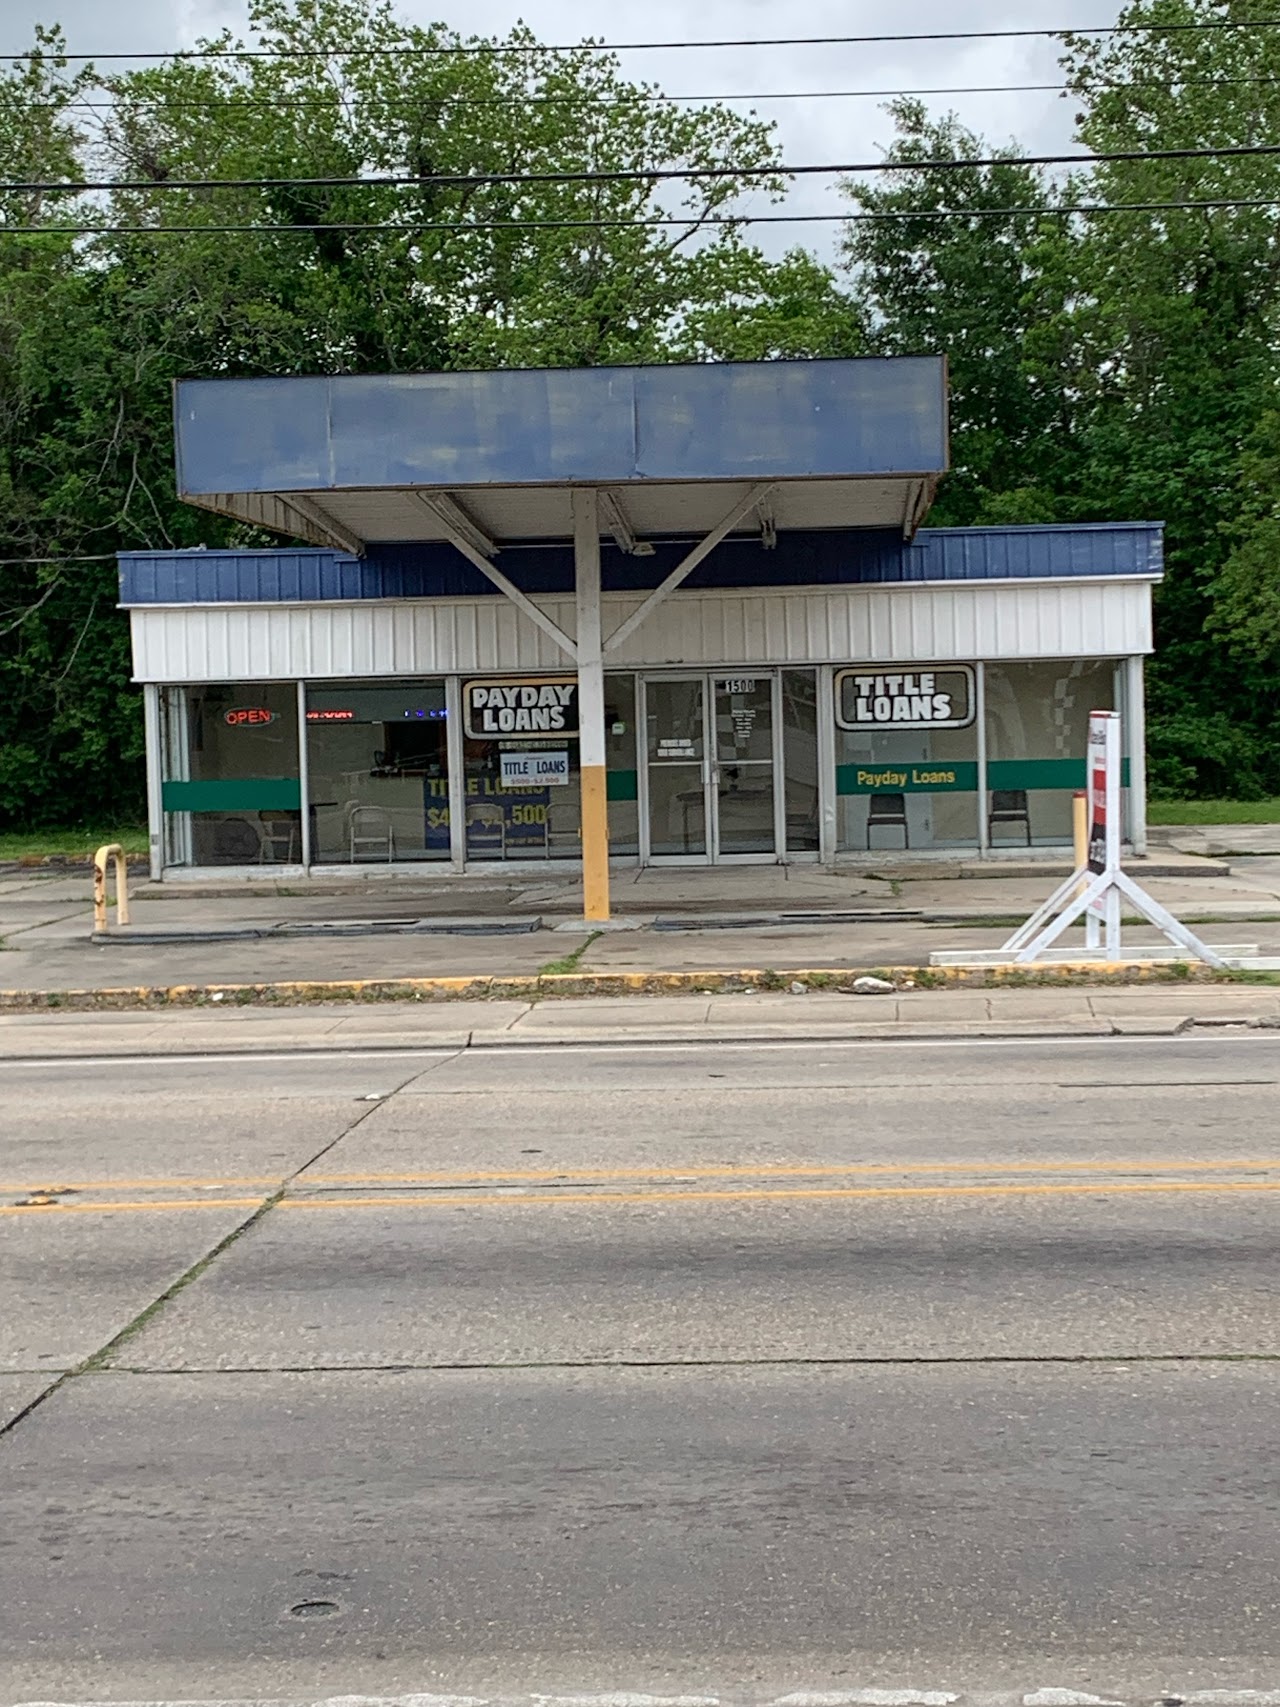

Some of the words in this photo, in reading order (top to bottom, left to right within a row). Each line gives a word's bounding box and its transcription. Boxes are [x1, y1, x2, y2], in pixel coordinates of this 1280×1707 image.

[727, 680, 754, 693] 1500
[854, 672, 936, 697] TITLE
[472, 685, 576, 708] PAYDAY
[225, 709, 271, 725] OPEN
[855, 694, 952, 722] LOANS
[483, 706, 566, 731] LOANS
[503, 761, 529, 775] TITLE
[536, 760, 566, 774] LOANS
[427, 778, 479, 797] TIE
[857, 771, 908, 787] Payday
[912, 769, 956, 785] Loans
